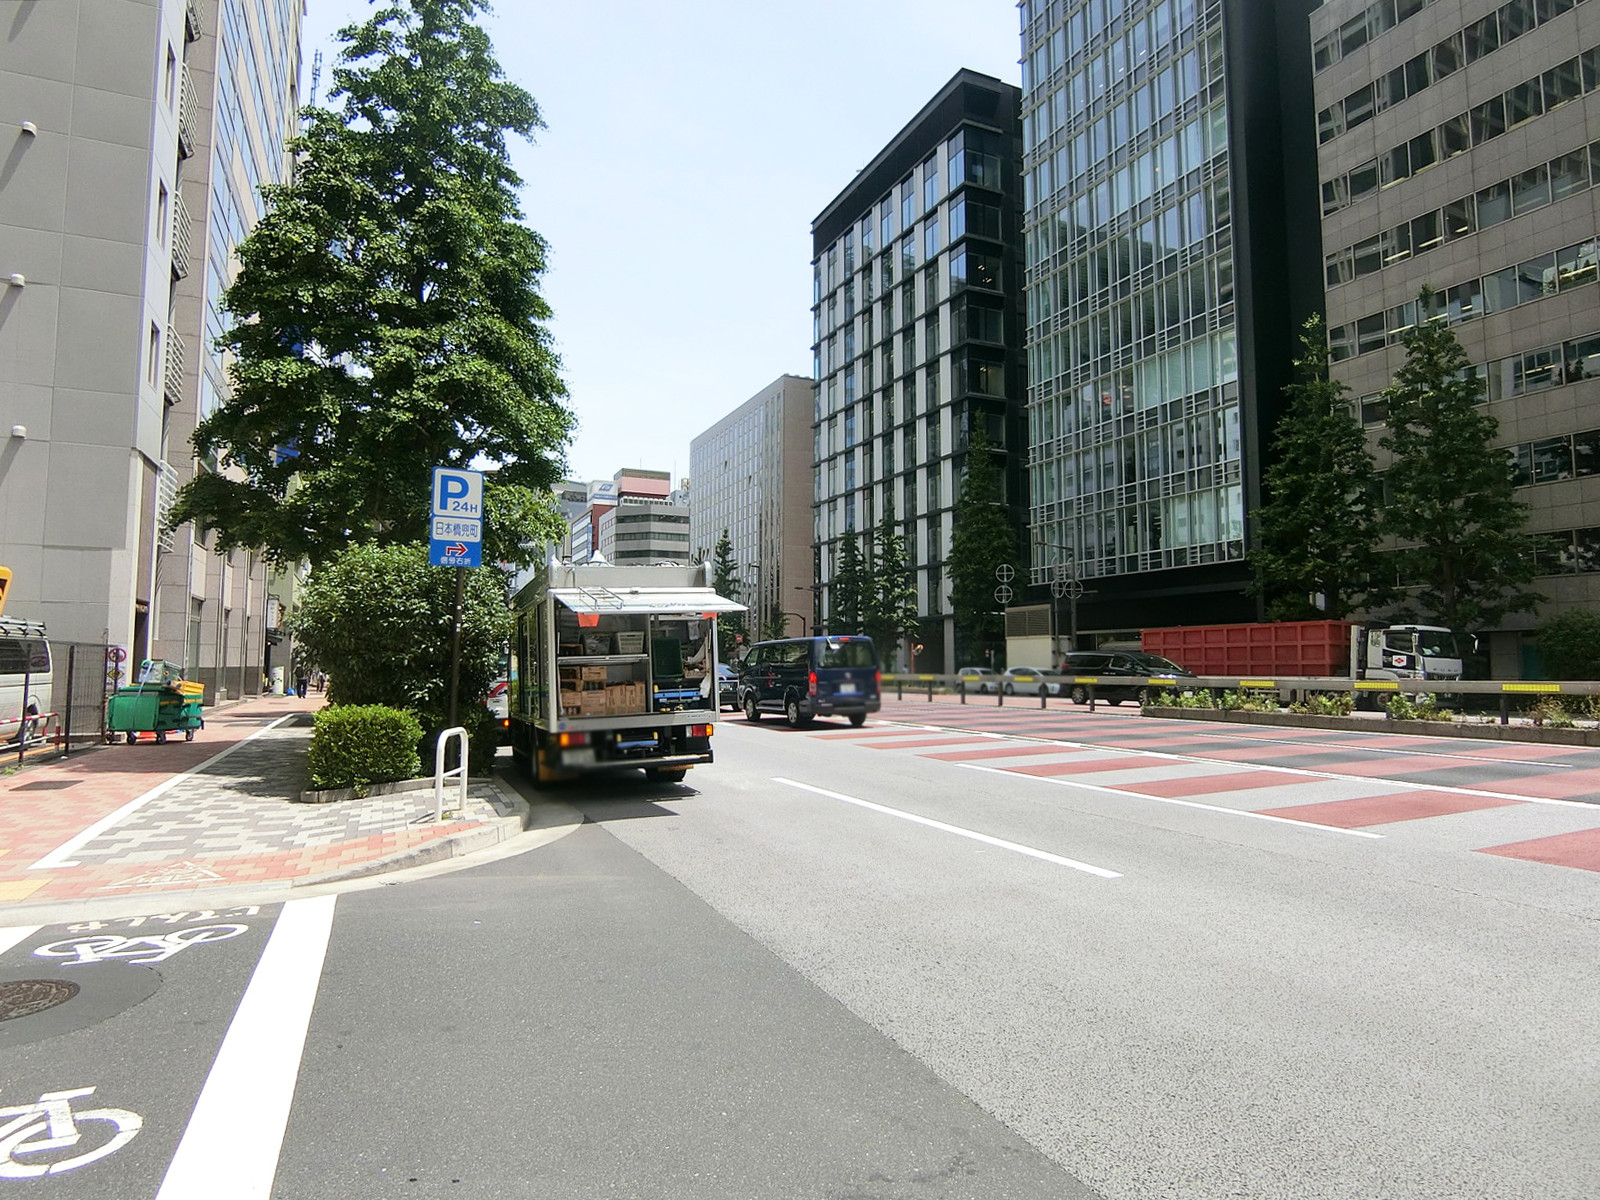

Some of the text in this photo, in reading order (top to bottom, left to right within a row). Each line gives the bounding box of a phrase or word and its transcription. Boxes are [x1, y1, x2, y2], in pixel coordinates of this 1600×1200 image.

[440, 475, 477, 513] P 24H
[436, 521, 478, 538] 日本橋兜町
